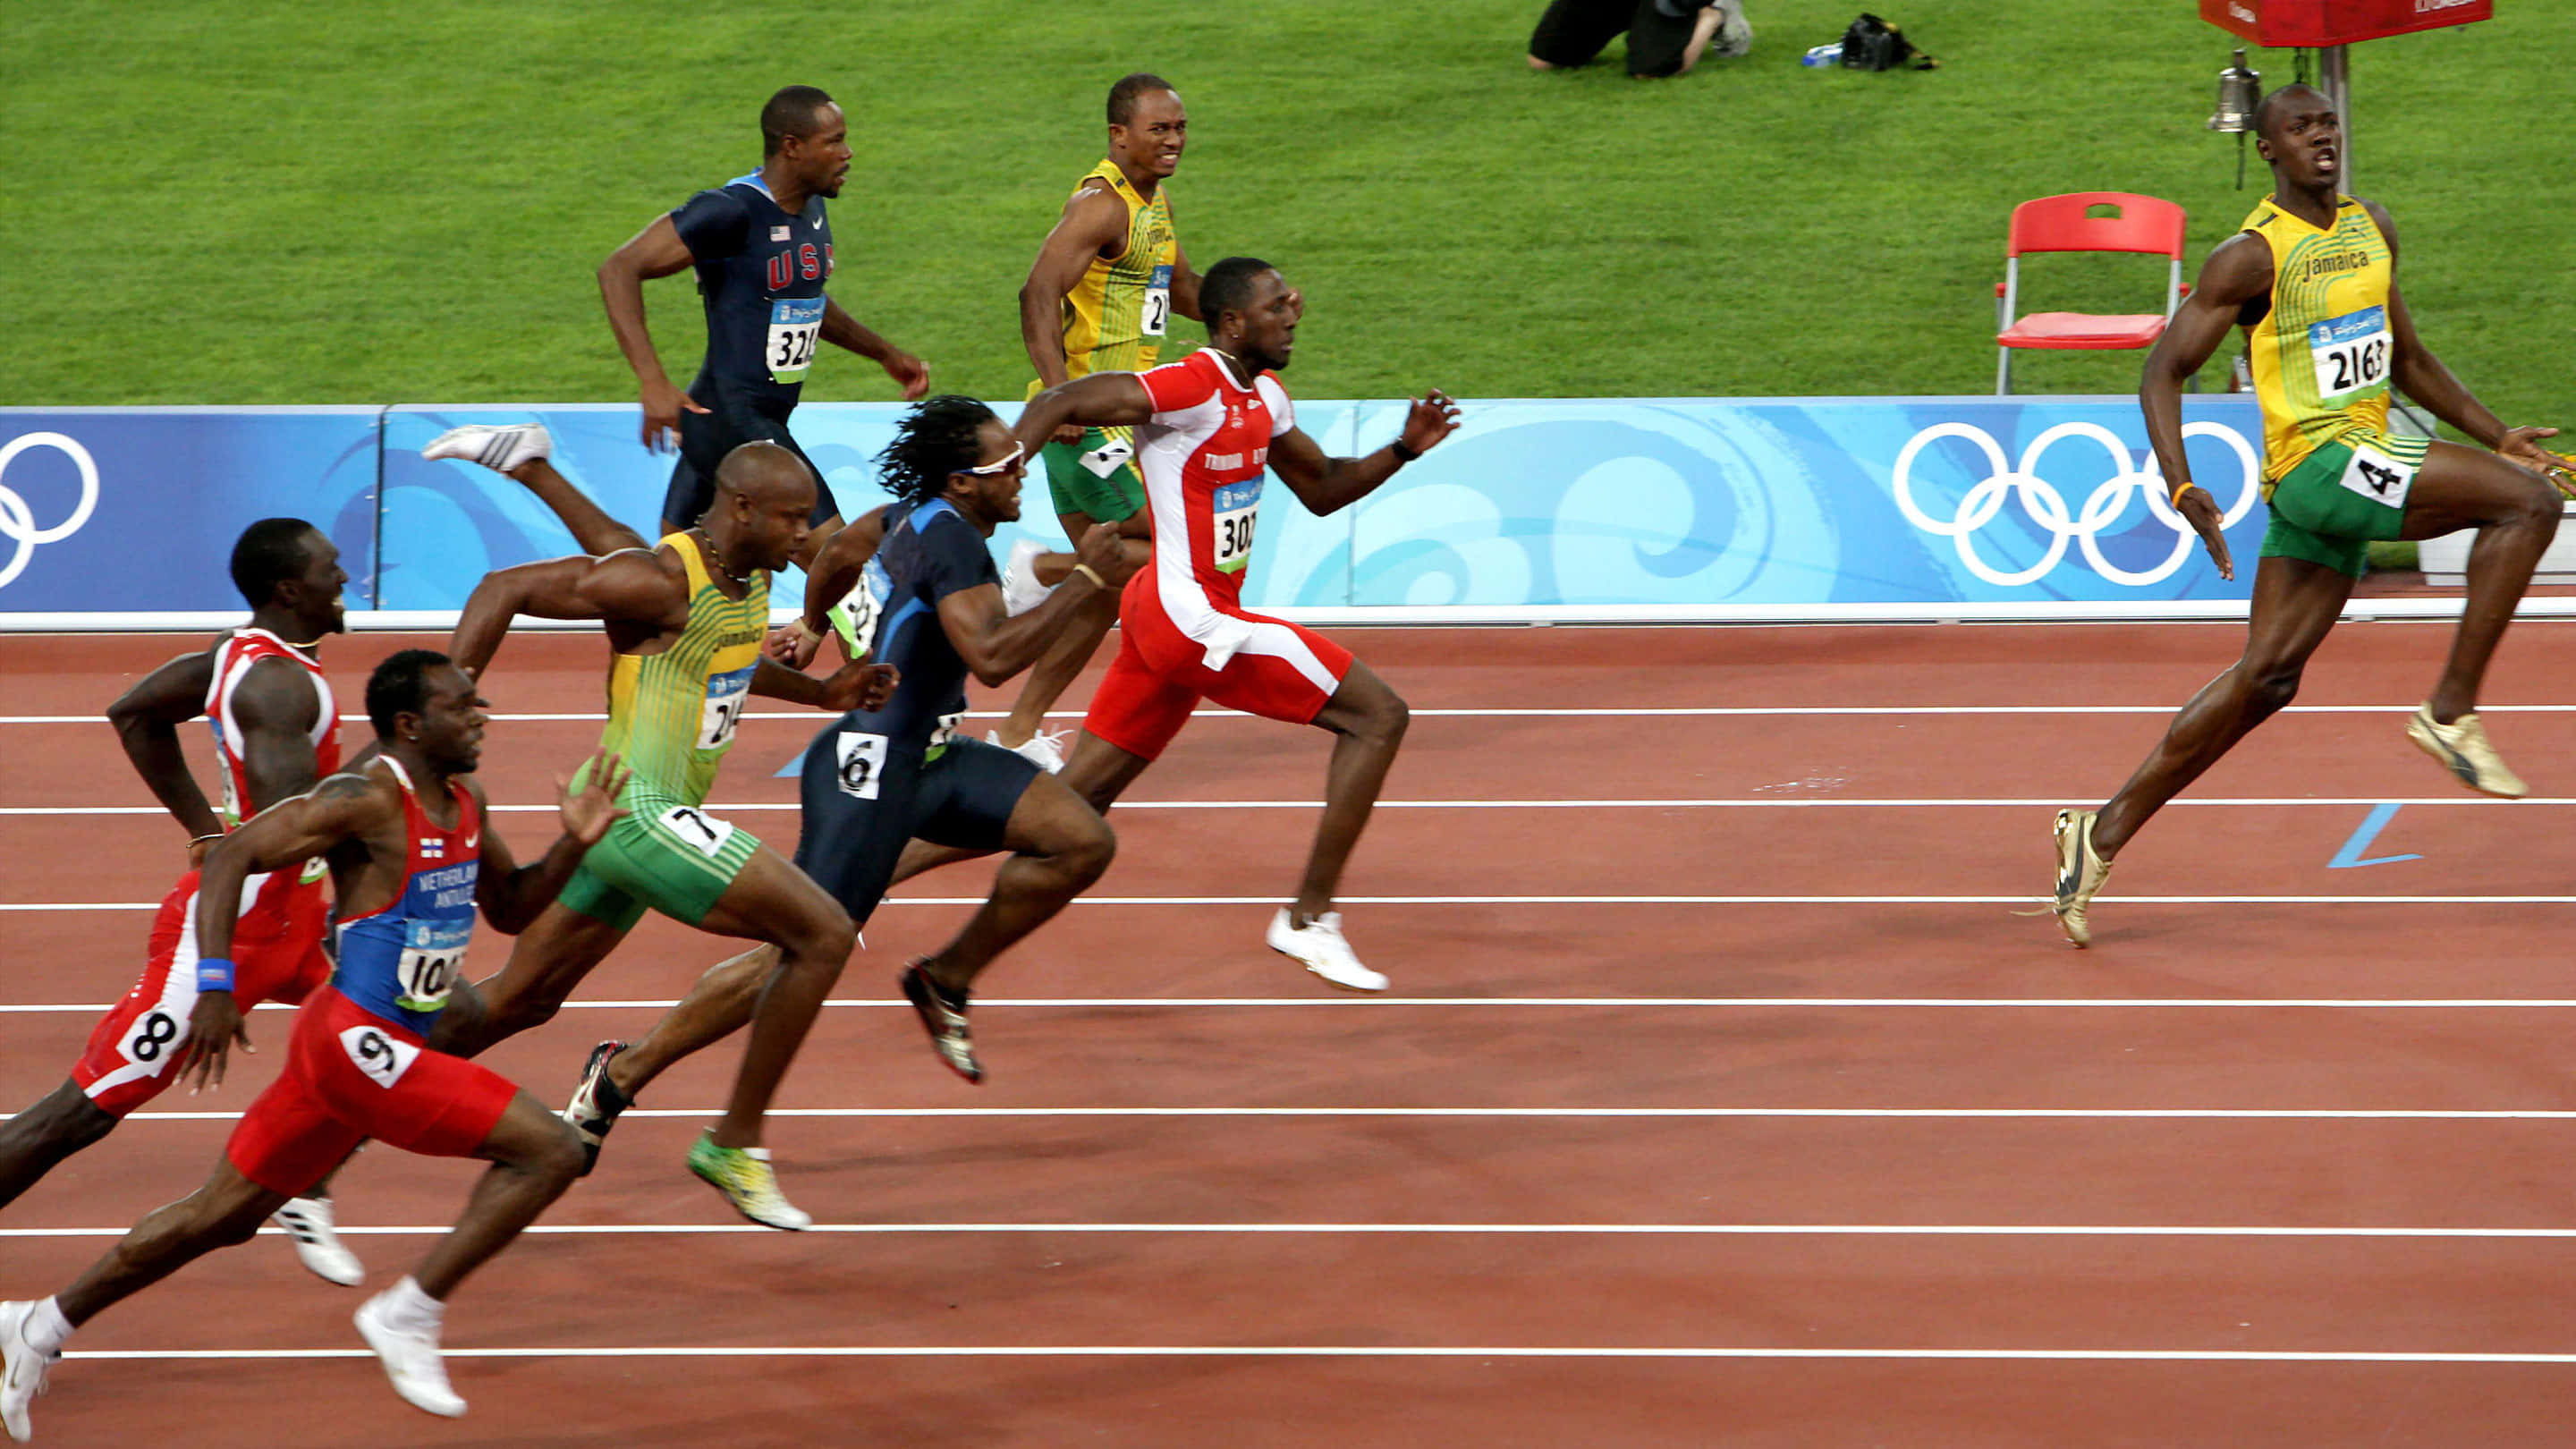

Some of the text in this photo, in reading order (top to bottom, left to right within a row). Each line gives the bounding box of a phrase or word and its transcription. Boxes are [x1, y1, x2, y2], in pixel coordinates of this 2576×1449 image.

[2329, 339, 2385, 391] 2163
[2358, 460, 2402, 494] 4
[843, 741, 871, 792] 6
[673, 809, 716, 841] 7
[132, 1013, 176, 1062] 8
[358, 1031, 394, 1072] 9
